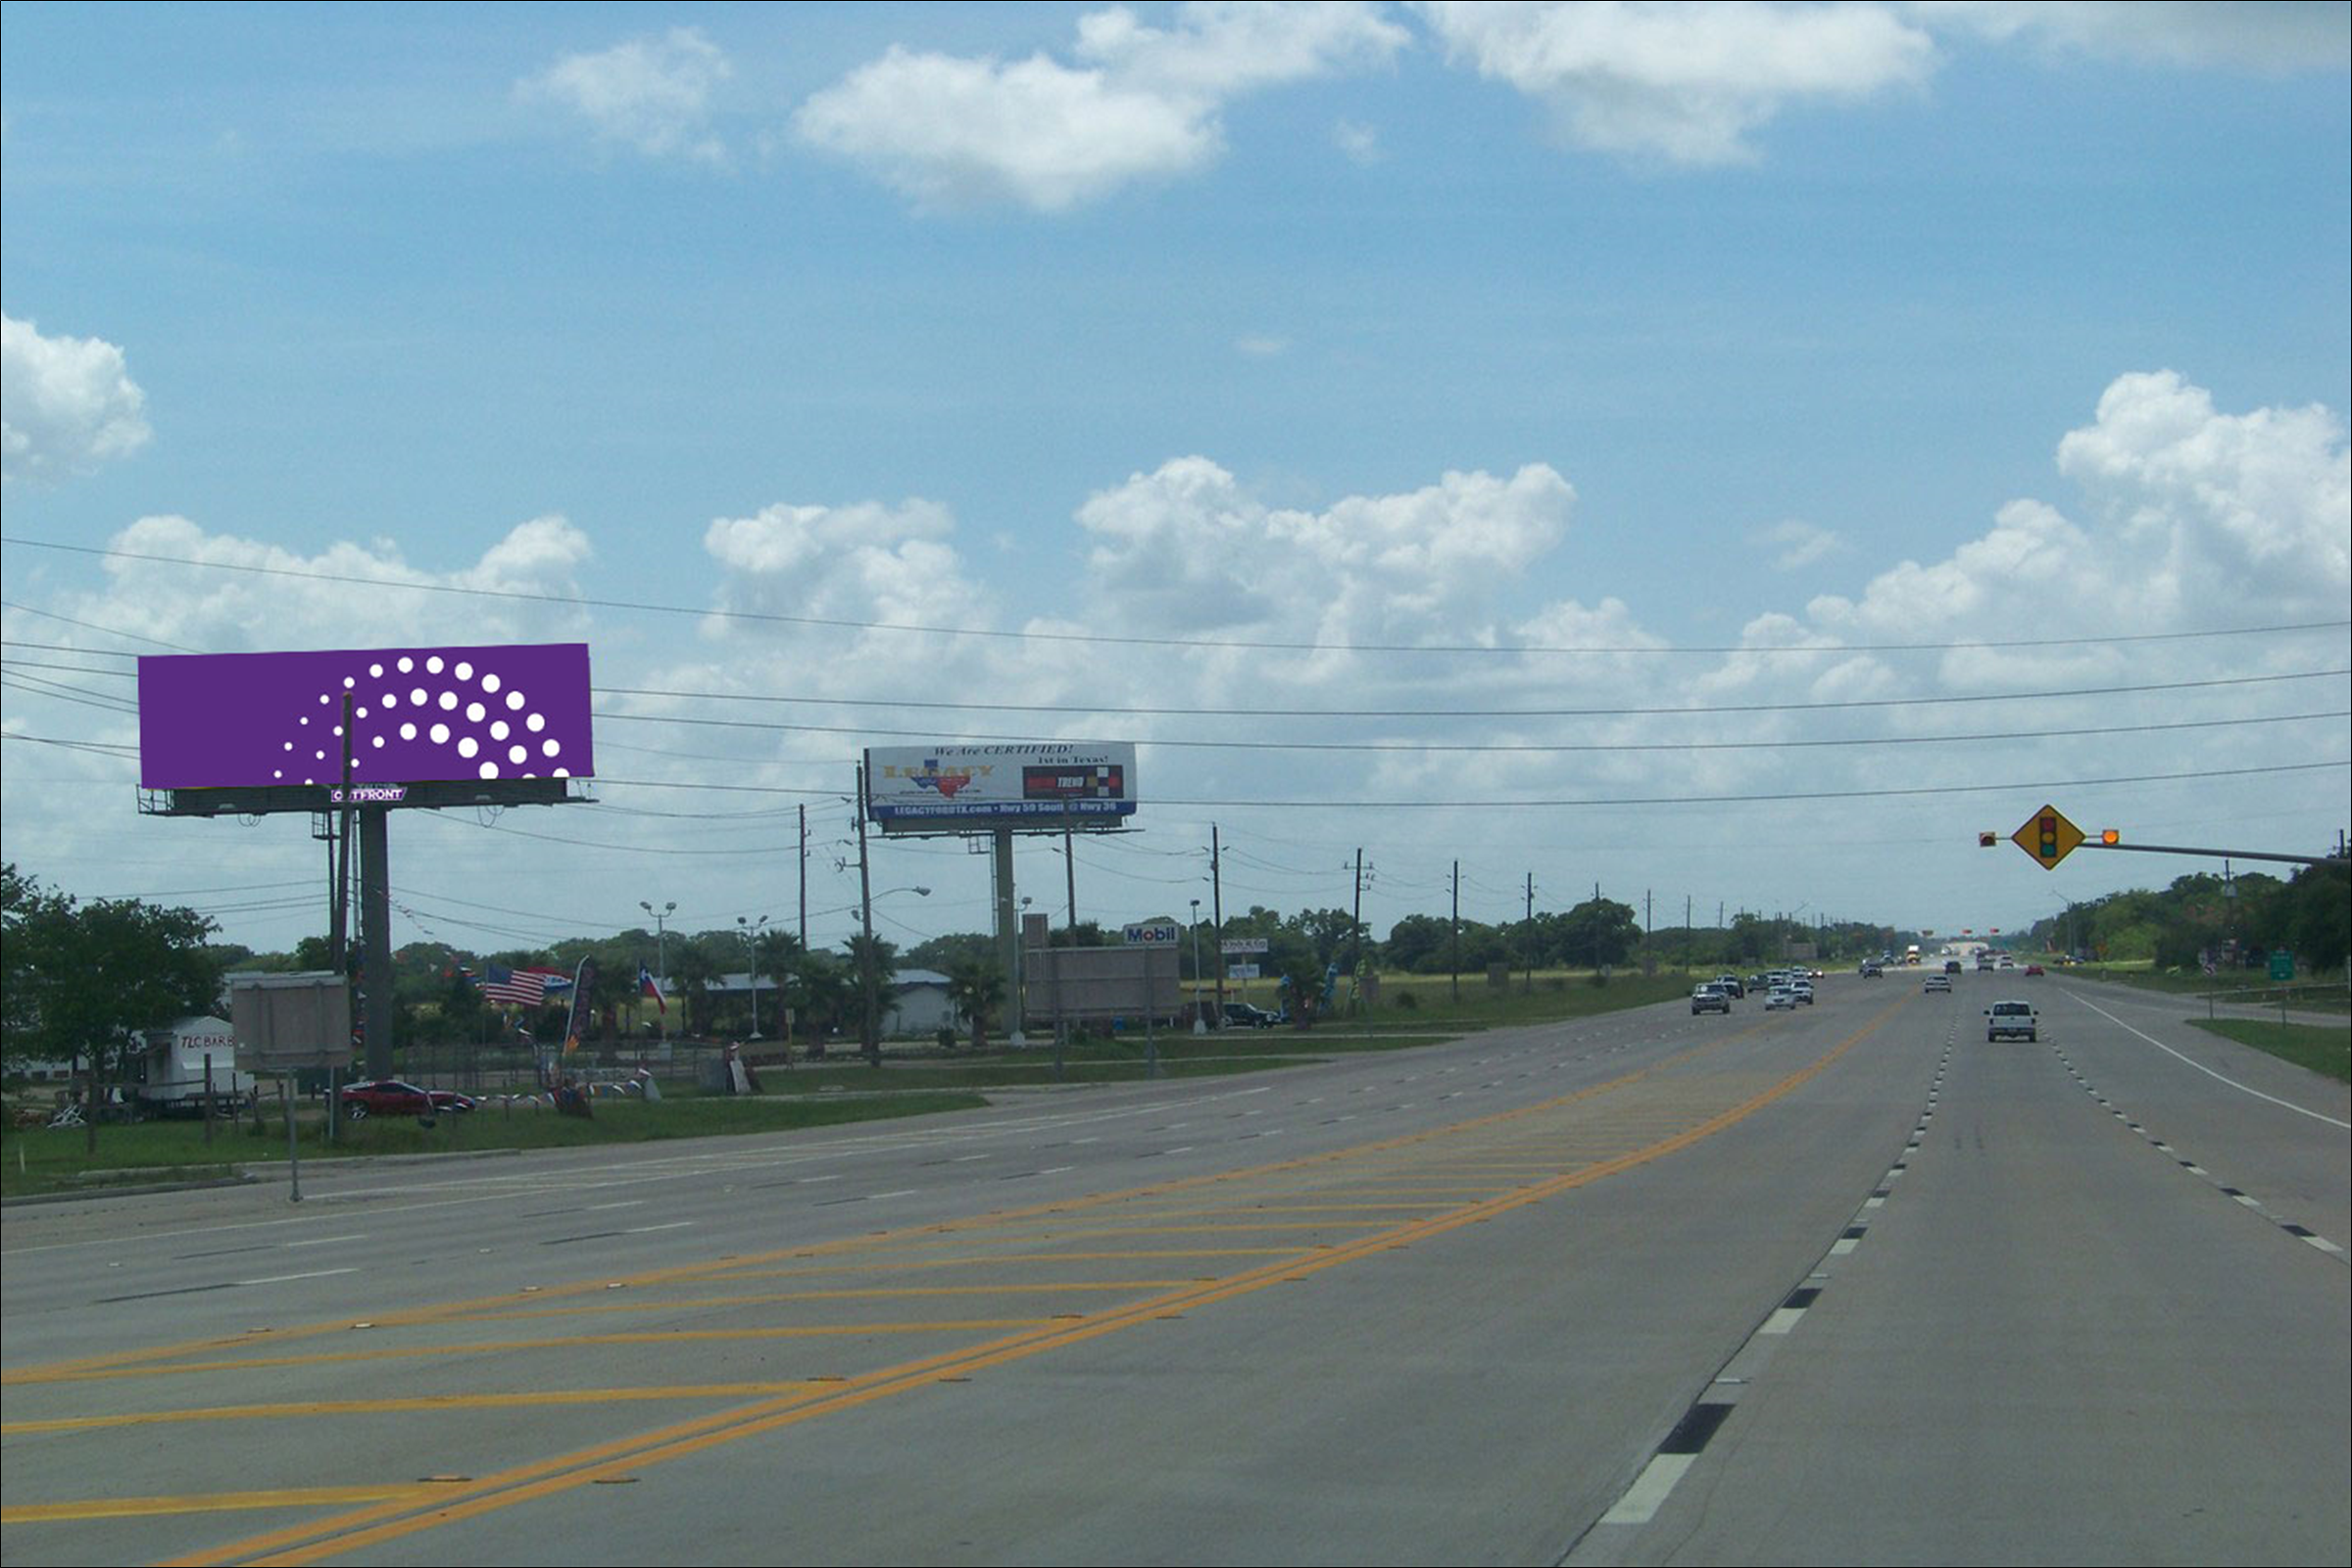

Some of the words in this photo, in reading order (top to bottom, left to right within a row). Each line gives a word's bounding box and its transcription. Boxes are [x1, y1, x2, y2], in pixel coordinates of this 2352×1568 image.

[935, 747, 955, 757] We
[958, 746, 980, 756] Are
[984, 744, 1074, 756] CERTIFIED!
[1039, 756, 1054, 764] 1st
[1057, 756, 1069, 764] in
[1073, 756, 1108, 764] Texas!
[883, 764, 995, 779] LEGACY
[333, 788, 403, 801] OTFRONT
[1127, 926, 1175, 942] Mobil
[181, 1035, 203, 1049] TLC
